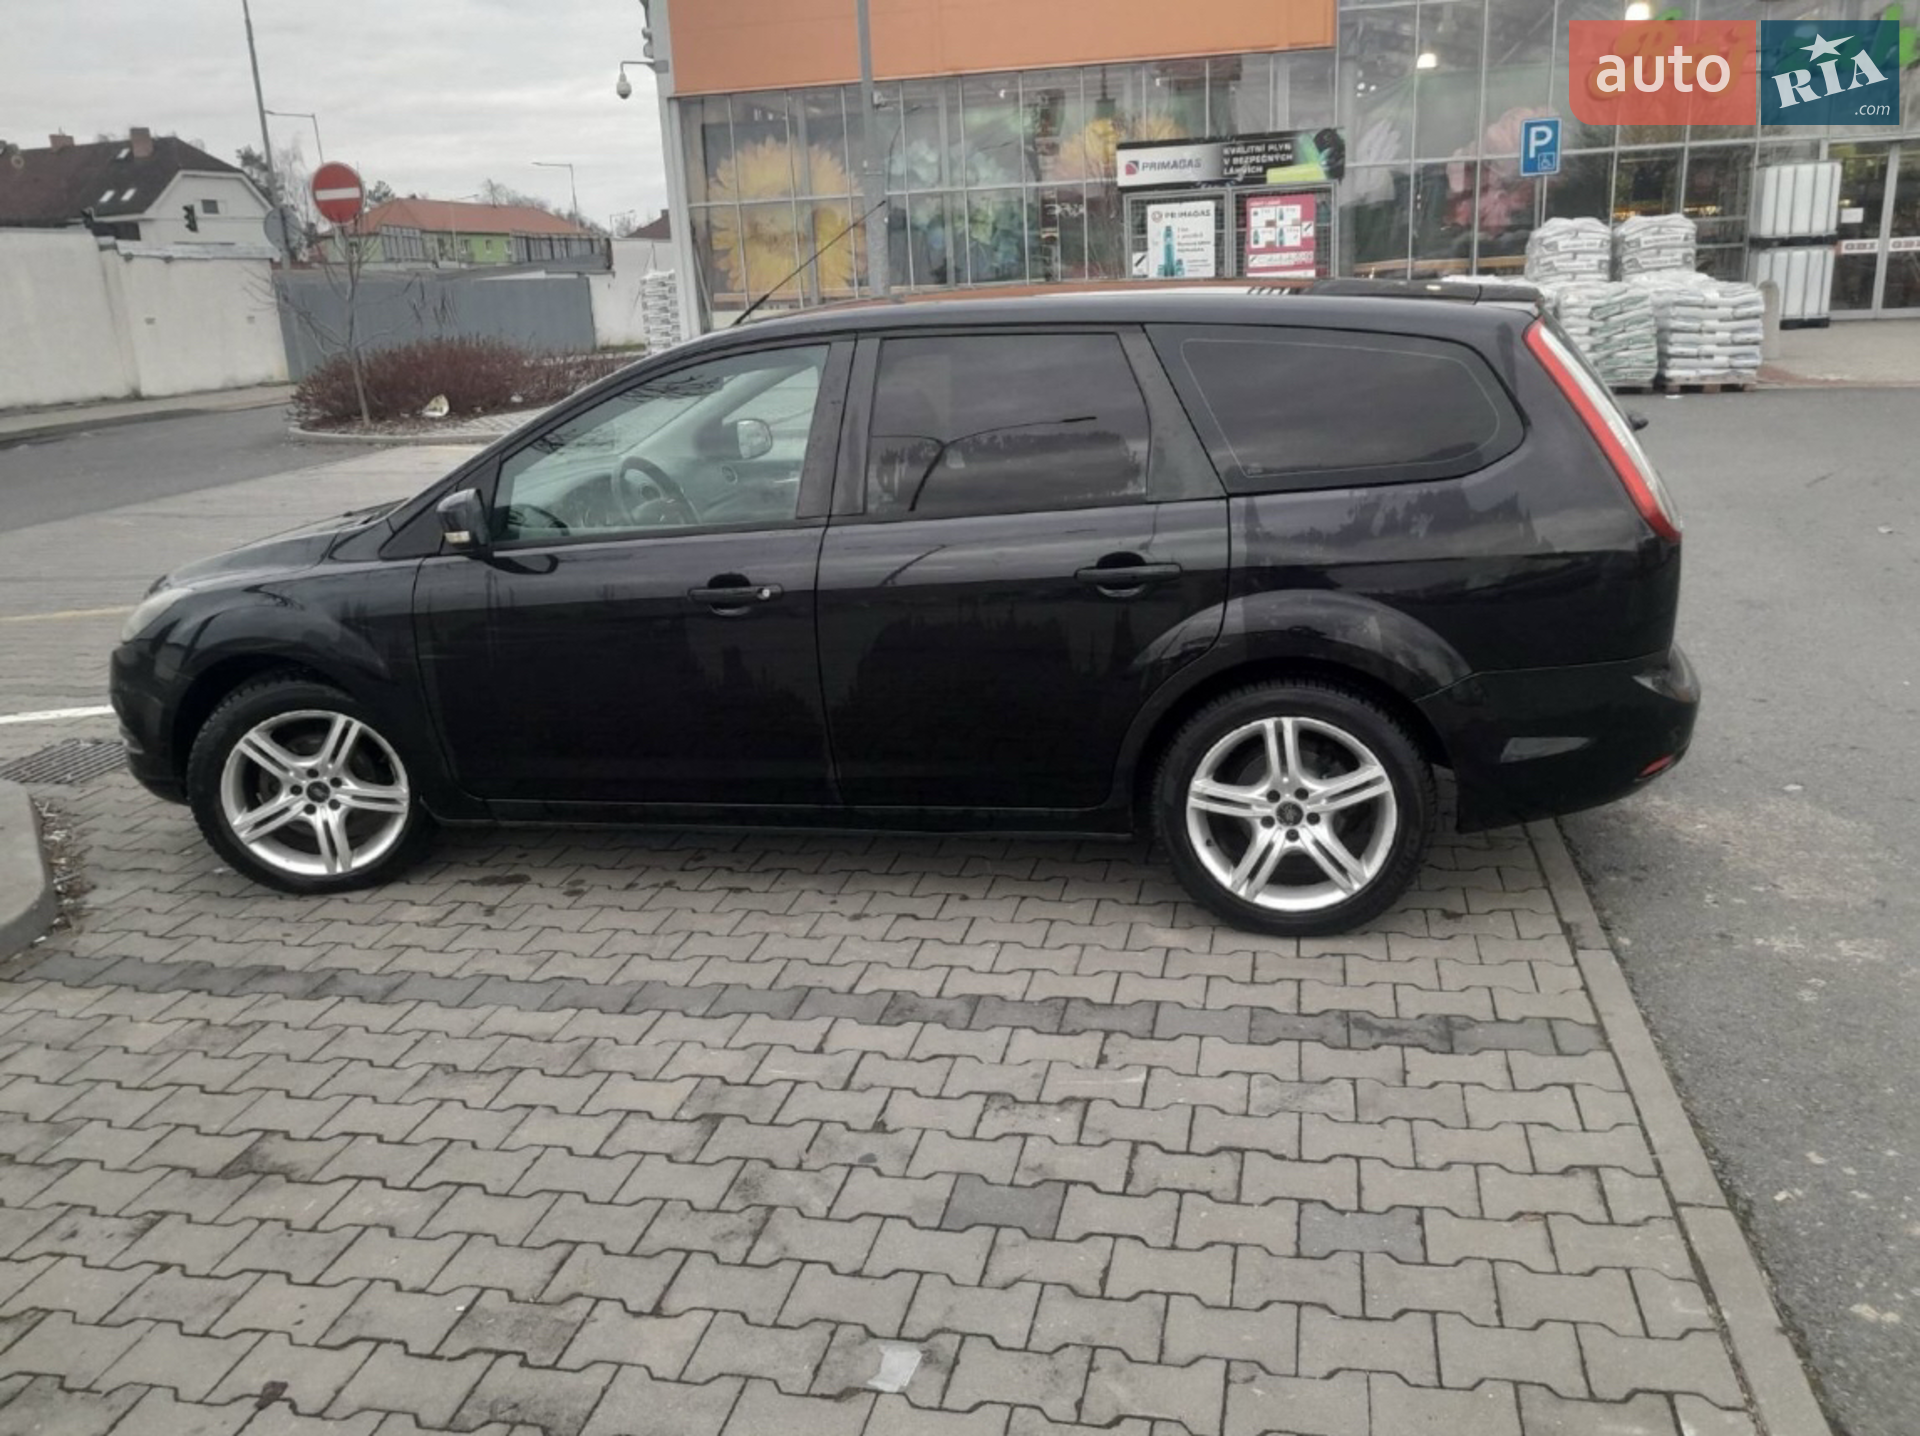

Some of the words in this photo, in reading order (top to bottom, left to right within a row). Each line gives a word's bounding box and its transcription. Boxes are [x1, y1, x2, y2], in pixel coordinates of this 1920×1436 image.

[1529, 125, 1553, 159] P
[1141, 157, 1202, 172] PRIMAGAS
[1223, 157, 1231, 165] V
